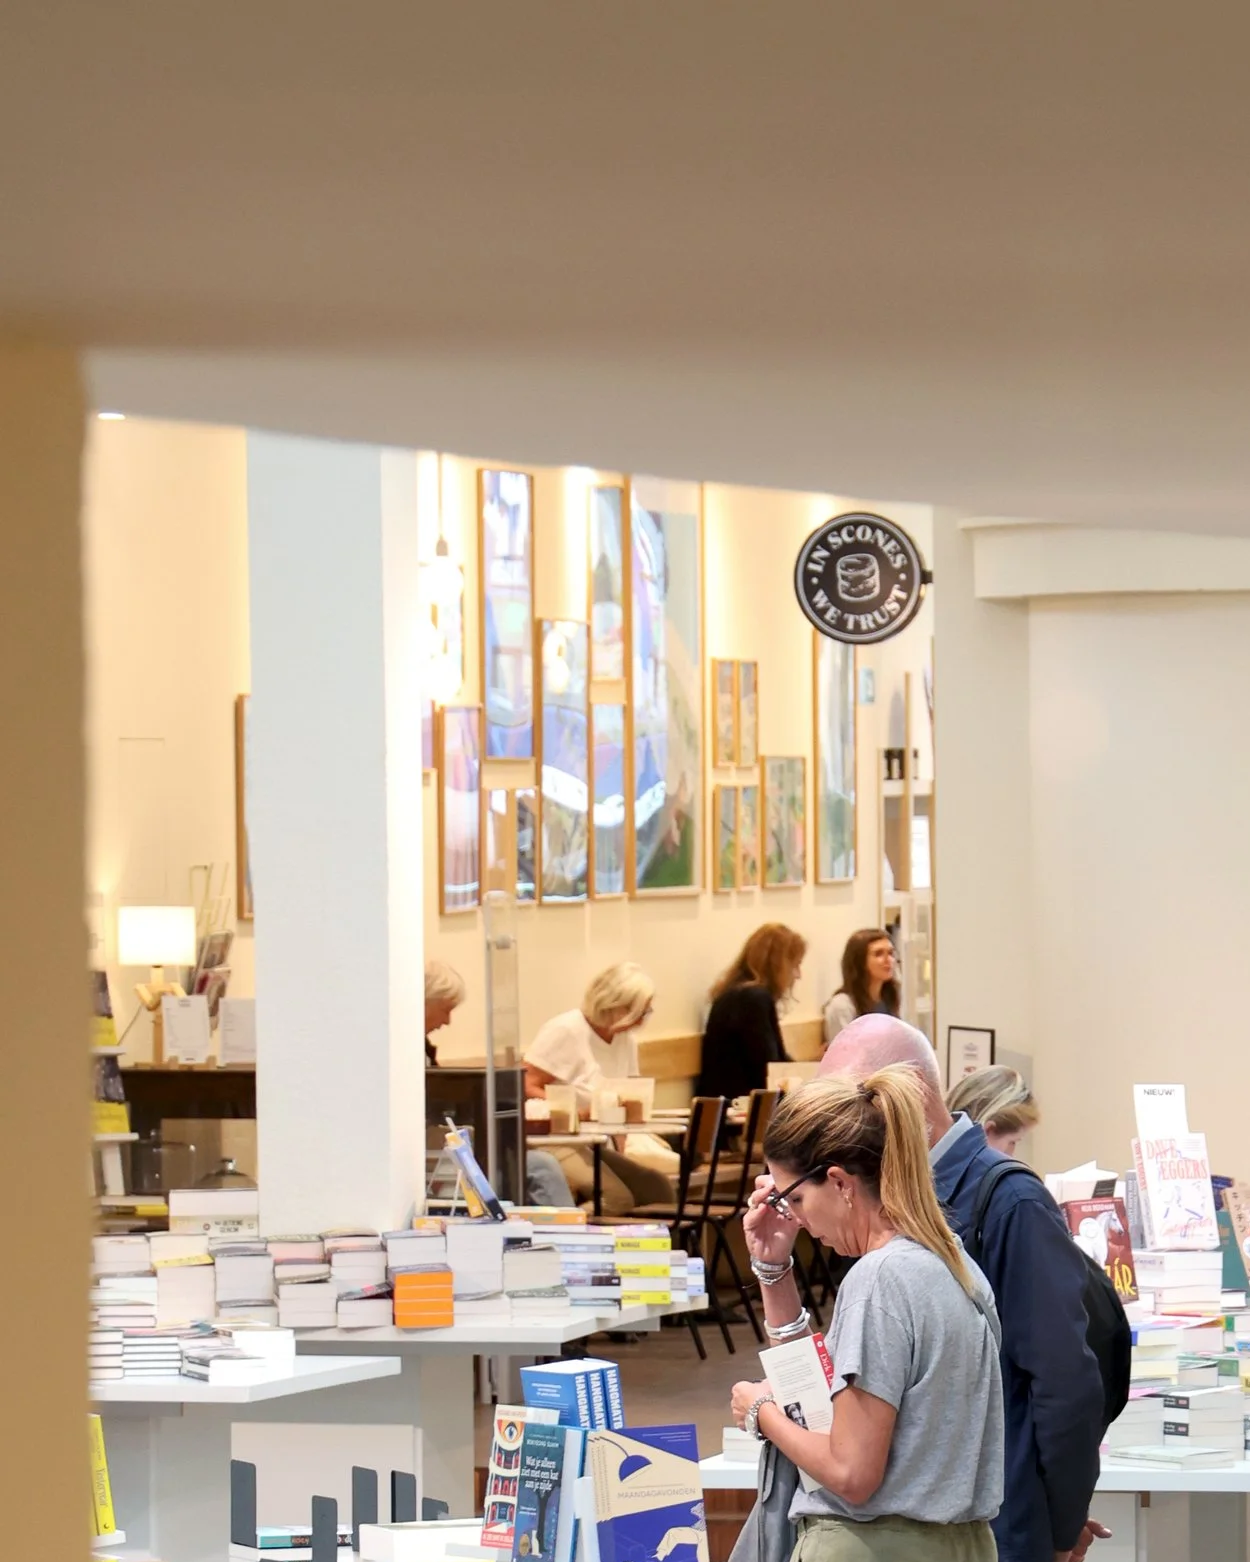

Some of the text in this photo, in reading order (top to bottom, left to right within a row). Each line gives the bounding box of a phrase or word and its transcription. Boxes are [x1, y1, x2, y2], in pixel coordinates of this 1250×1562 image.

[807, 524, 908, 574] IN SCONES
[812, 584, 908, 632] WE TRUST
[1145, 1138, 1178, 1160] DAVE
[1161, 1158, 1209, 1181] EGGERS
[617, 1487, 696, 1499] MAANDAGAVONDEN
